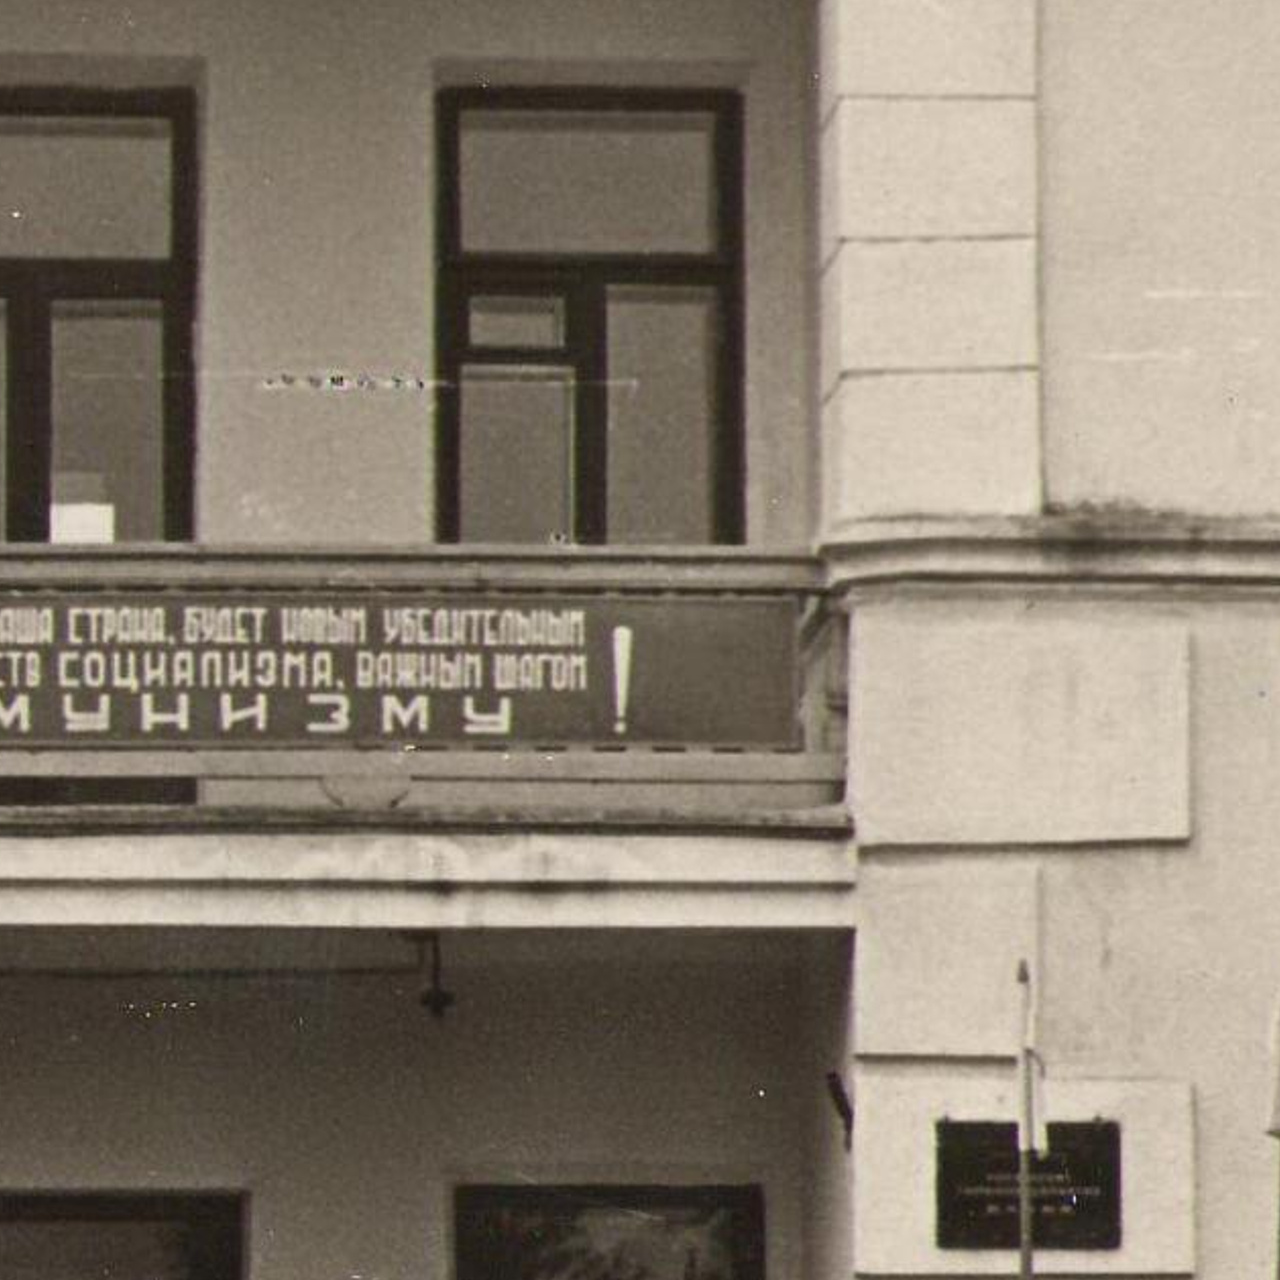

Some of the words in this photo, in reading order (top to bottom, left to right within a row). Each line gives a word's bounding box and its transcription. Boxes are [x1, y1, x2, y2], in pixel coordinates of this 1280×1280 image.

[68, 607, 176, 647] СТРАНА,
[183, 607, 267, 645] БУДЕТ
[281, 607, 367, 646] НОВЫМ
[383, 608, 585, 646] УБЕДИТЕЛЬНЫМ
[58, 651, 345, 693] СОЦИАЛИЗМА,
[356, 651, 483, 691] ВАЖНЫМ
[494, 653, 588, 691] ШАГОМ
